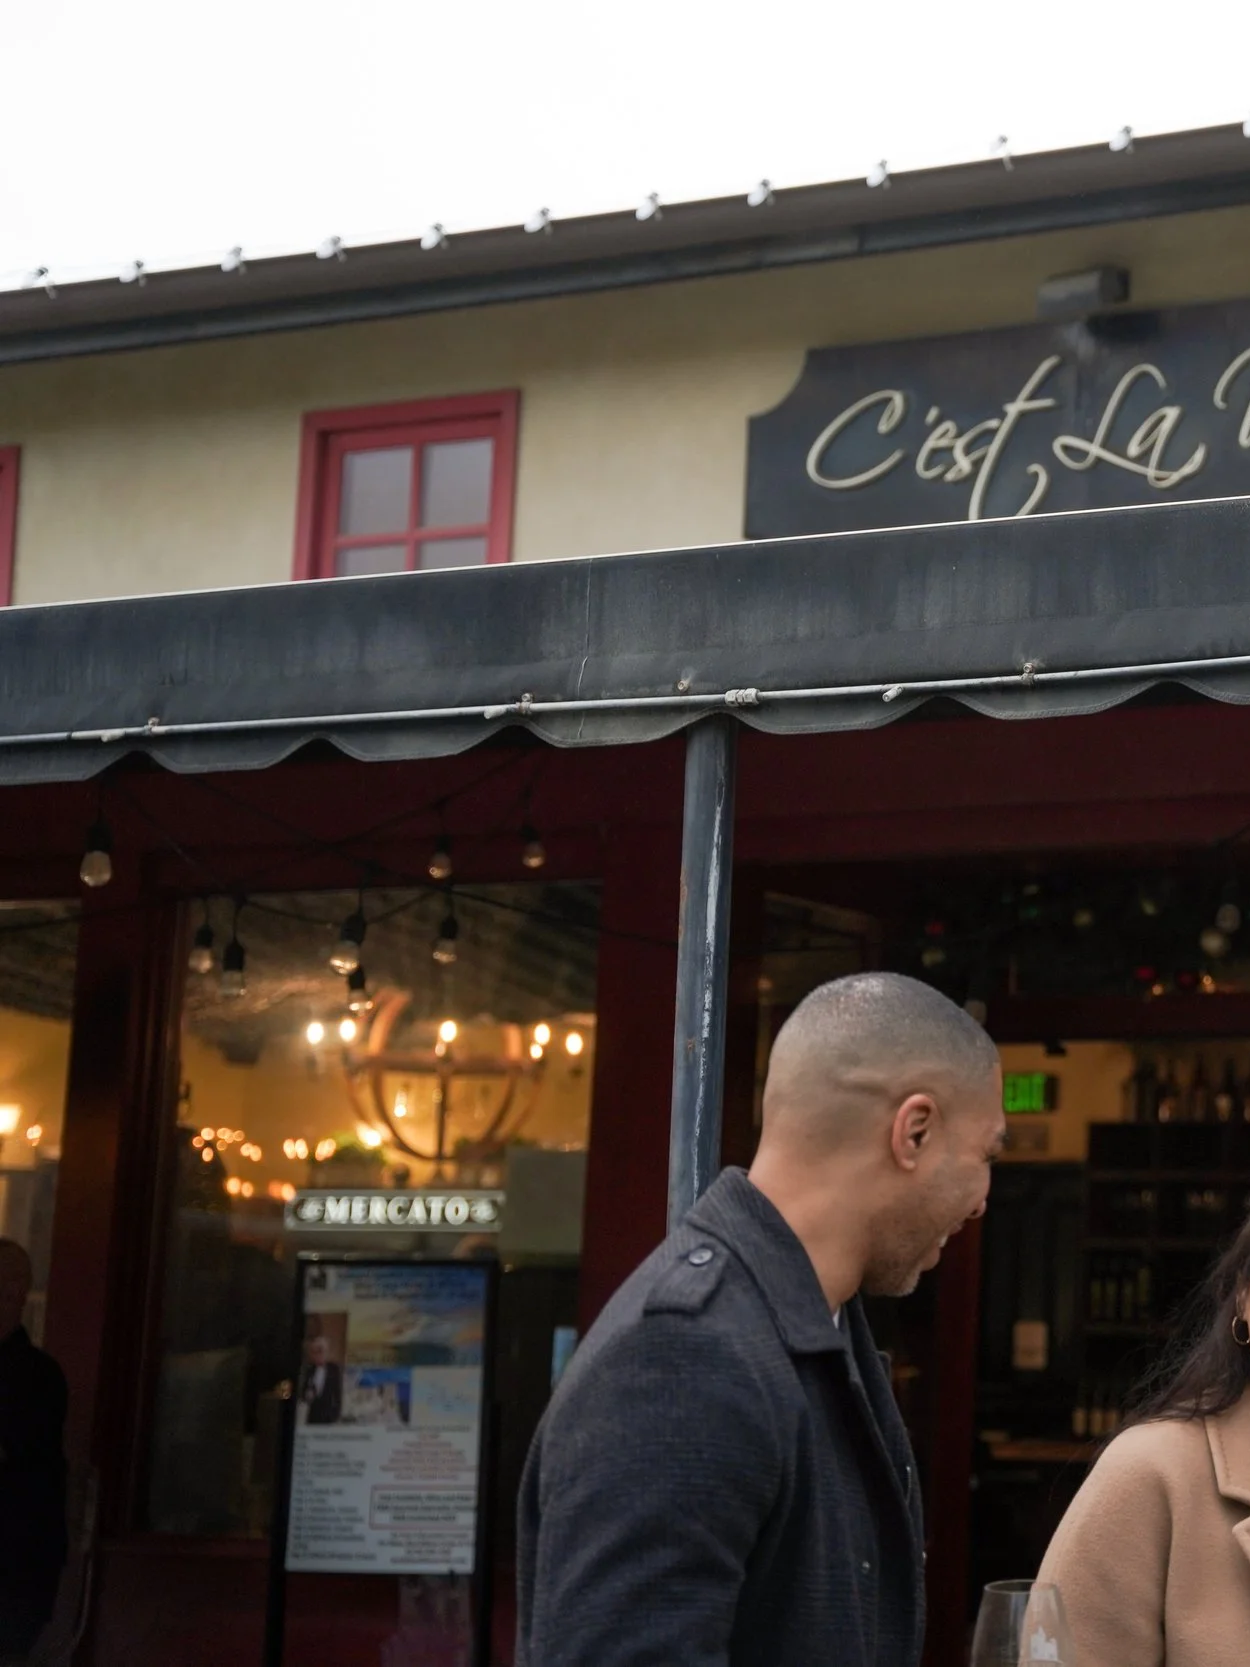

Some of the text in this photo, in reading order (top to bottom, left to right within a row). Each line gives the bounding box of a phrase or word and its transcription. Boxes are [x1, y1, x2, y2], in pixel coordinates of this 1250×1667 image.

[806, 355, 1056, 521] C'est
[1053, 363, 1206, 487] La
[323, 1195, 470, 1225] MERCATO
